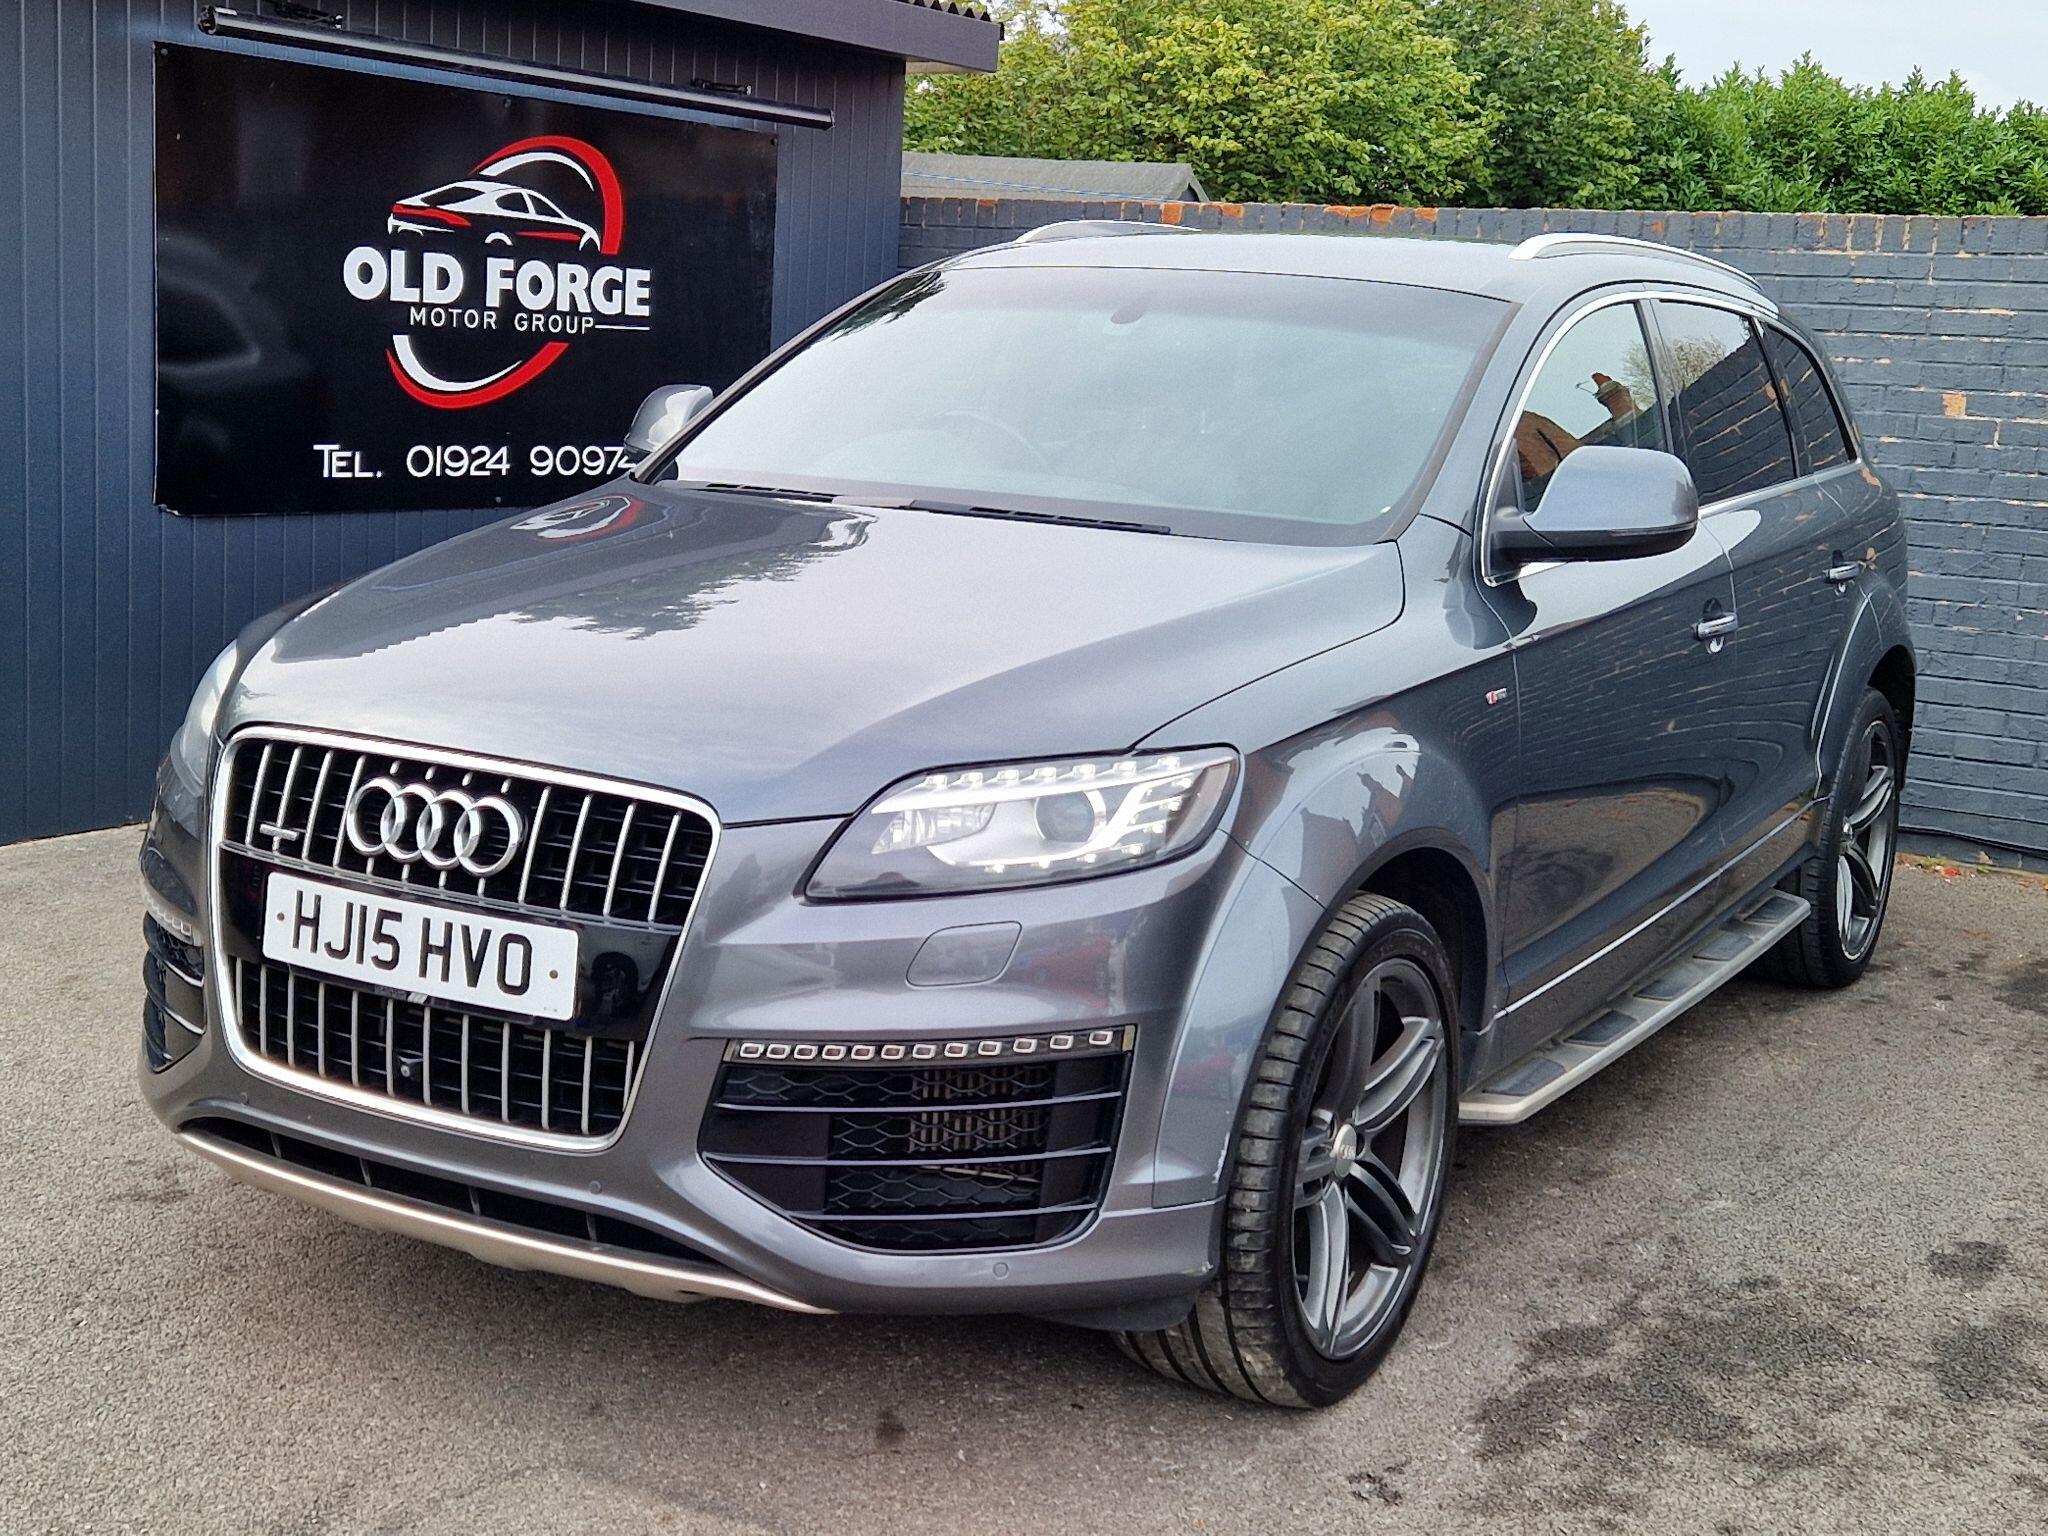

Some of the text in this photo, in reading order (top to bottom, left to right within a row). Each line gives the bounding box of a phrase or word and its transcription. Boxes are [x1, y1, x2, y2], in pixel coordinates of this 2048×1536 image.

[343, 247, 651, 317] OLD FORGE
[410, 306, 594, 335] MOTOR GROUP
[406, 445, 511, 477] 01924
[291, 890, 532, 995] HJ15 HVO
